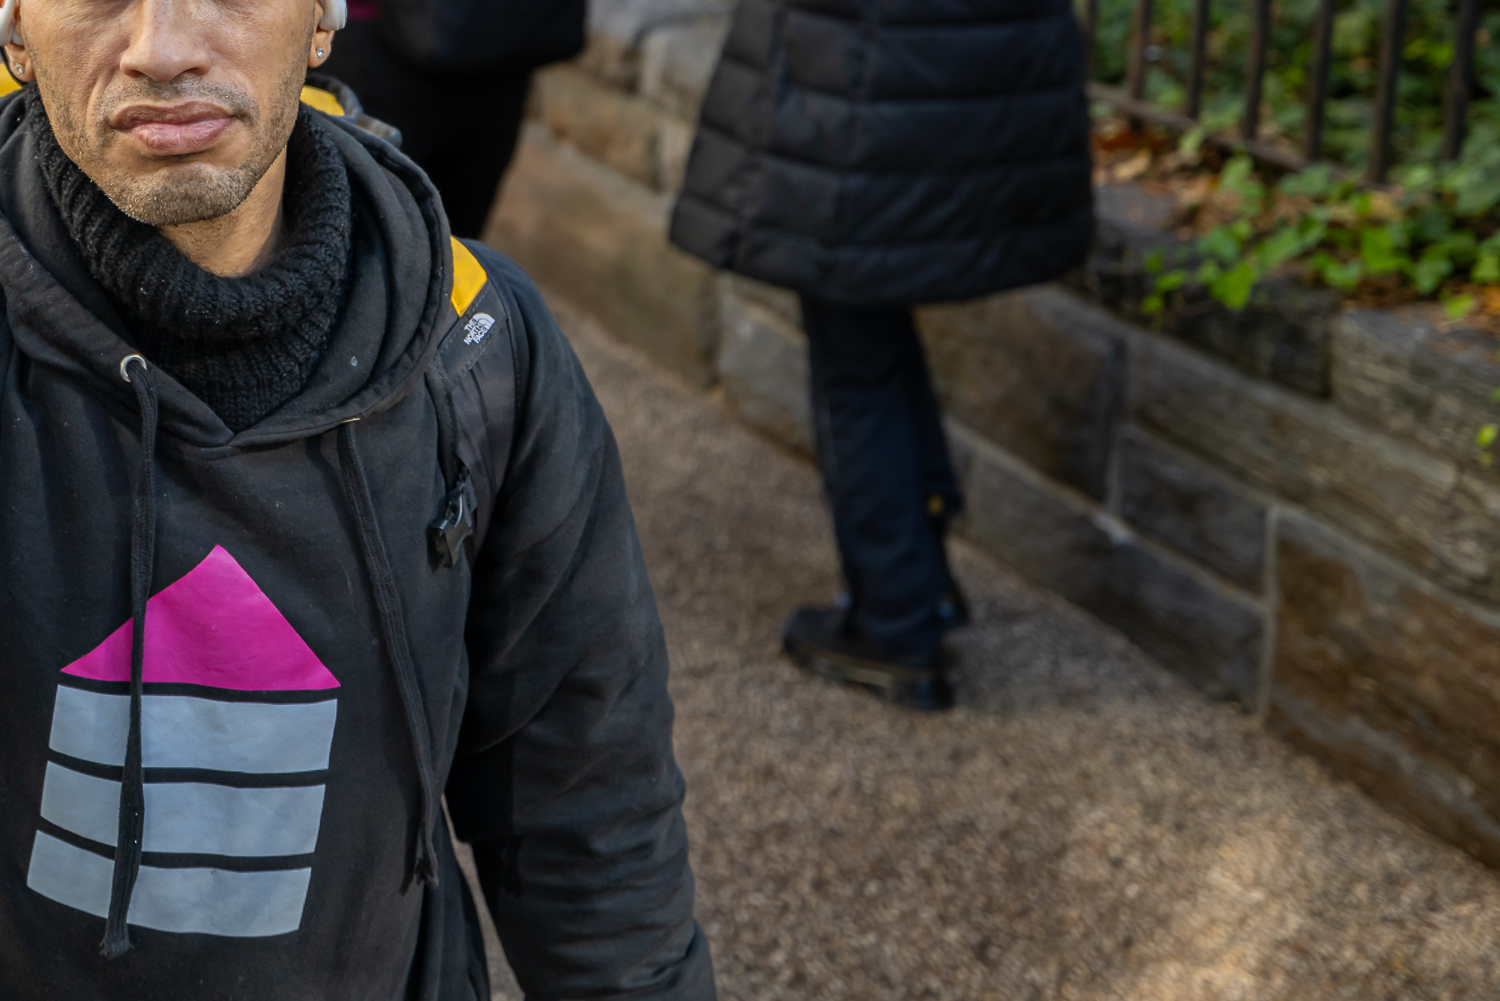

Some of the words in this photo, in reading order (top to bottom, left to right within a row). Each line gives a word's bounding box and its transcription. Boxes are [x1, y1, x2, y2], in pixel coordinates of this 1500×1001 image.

[463, 322, 484, 345] NORTH
[464, 318, 477, 332] THE
[473, 326, 488, 344] FACE
